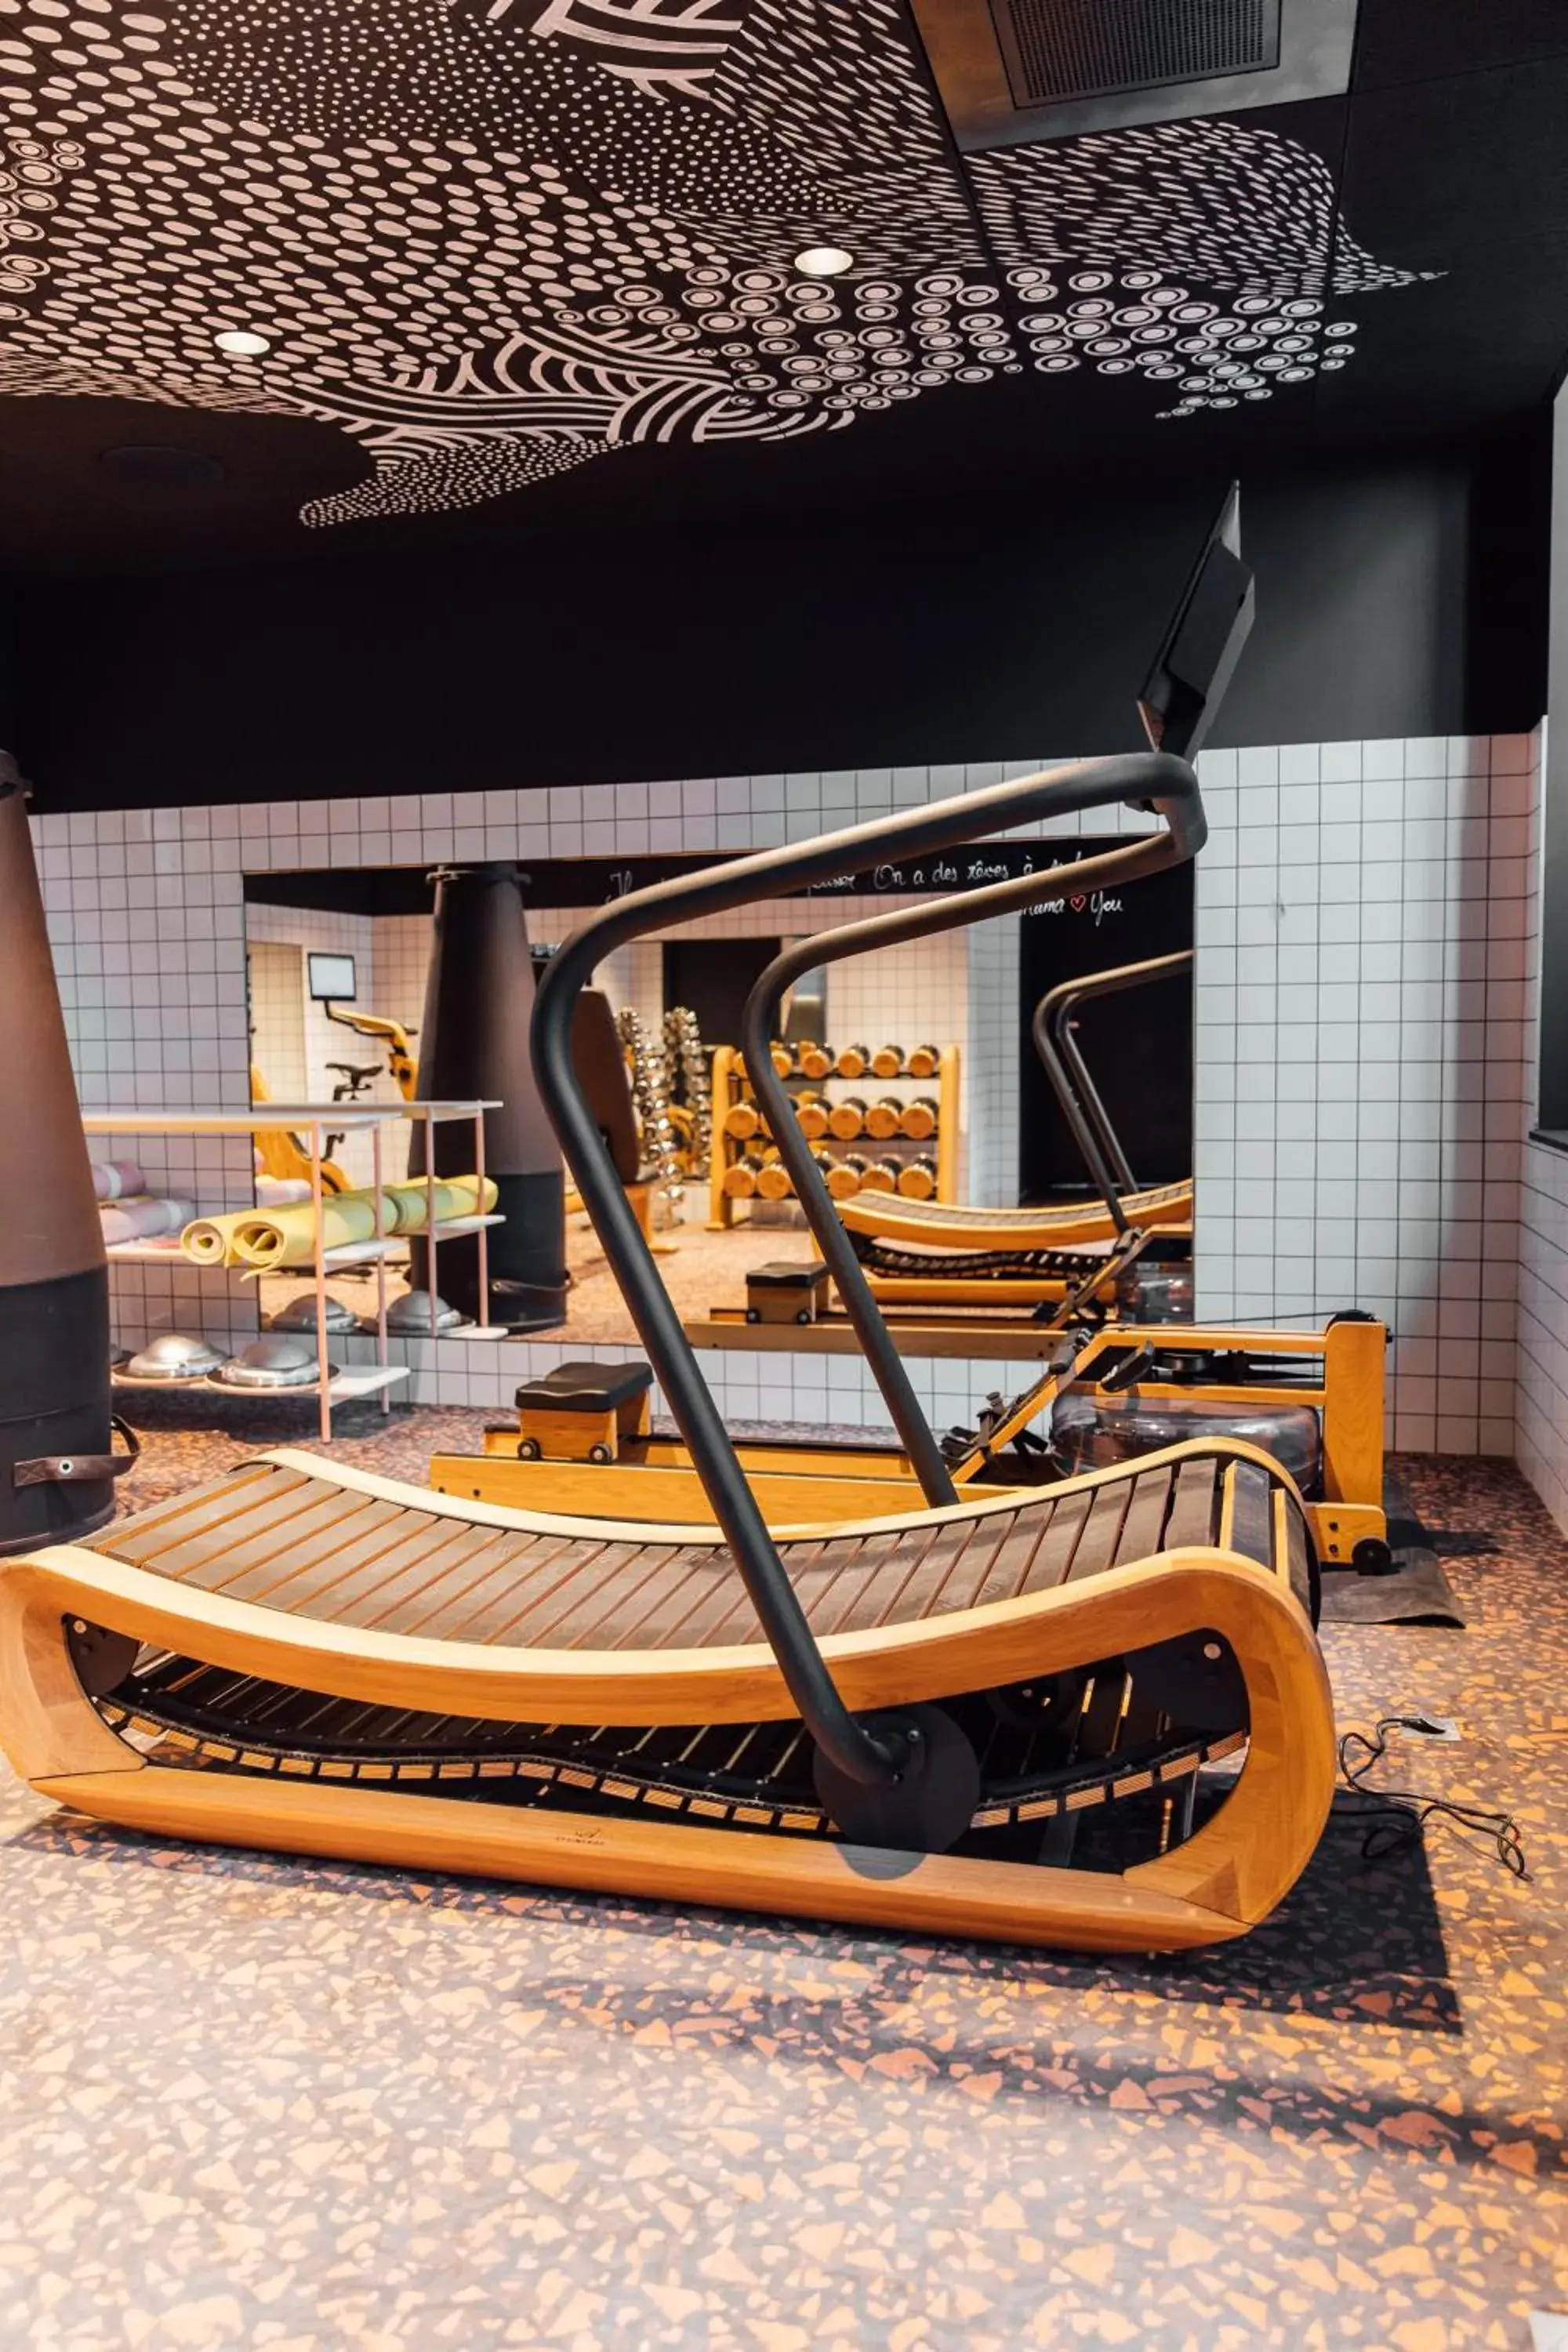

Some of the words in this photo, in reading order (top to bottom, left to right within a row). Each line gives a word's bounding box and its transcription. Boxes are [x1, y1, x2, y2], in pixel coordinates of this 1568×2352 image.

[873, 864, 906, 890] On
[913, 869, 925, 885] a
[931, 861, 957, 883] des
[967, 860, 1010, 880] rêves
[1090, 890, 1123, 927] You
